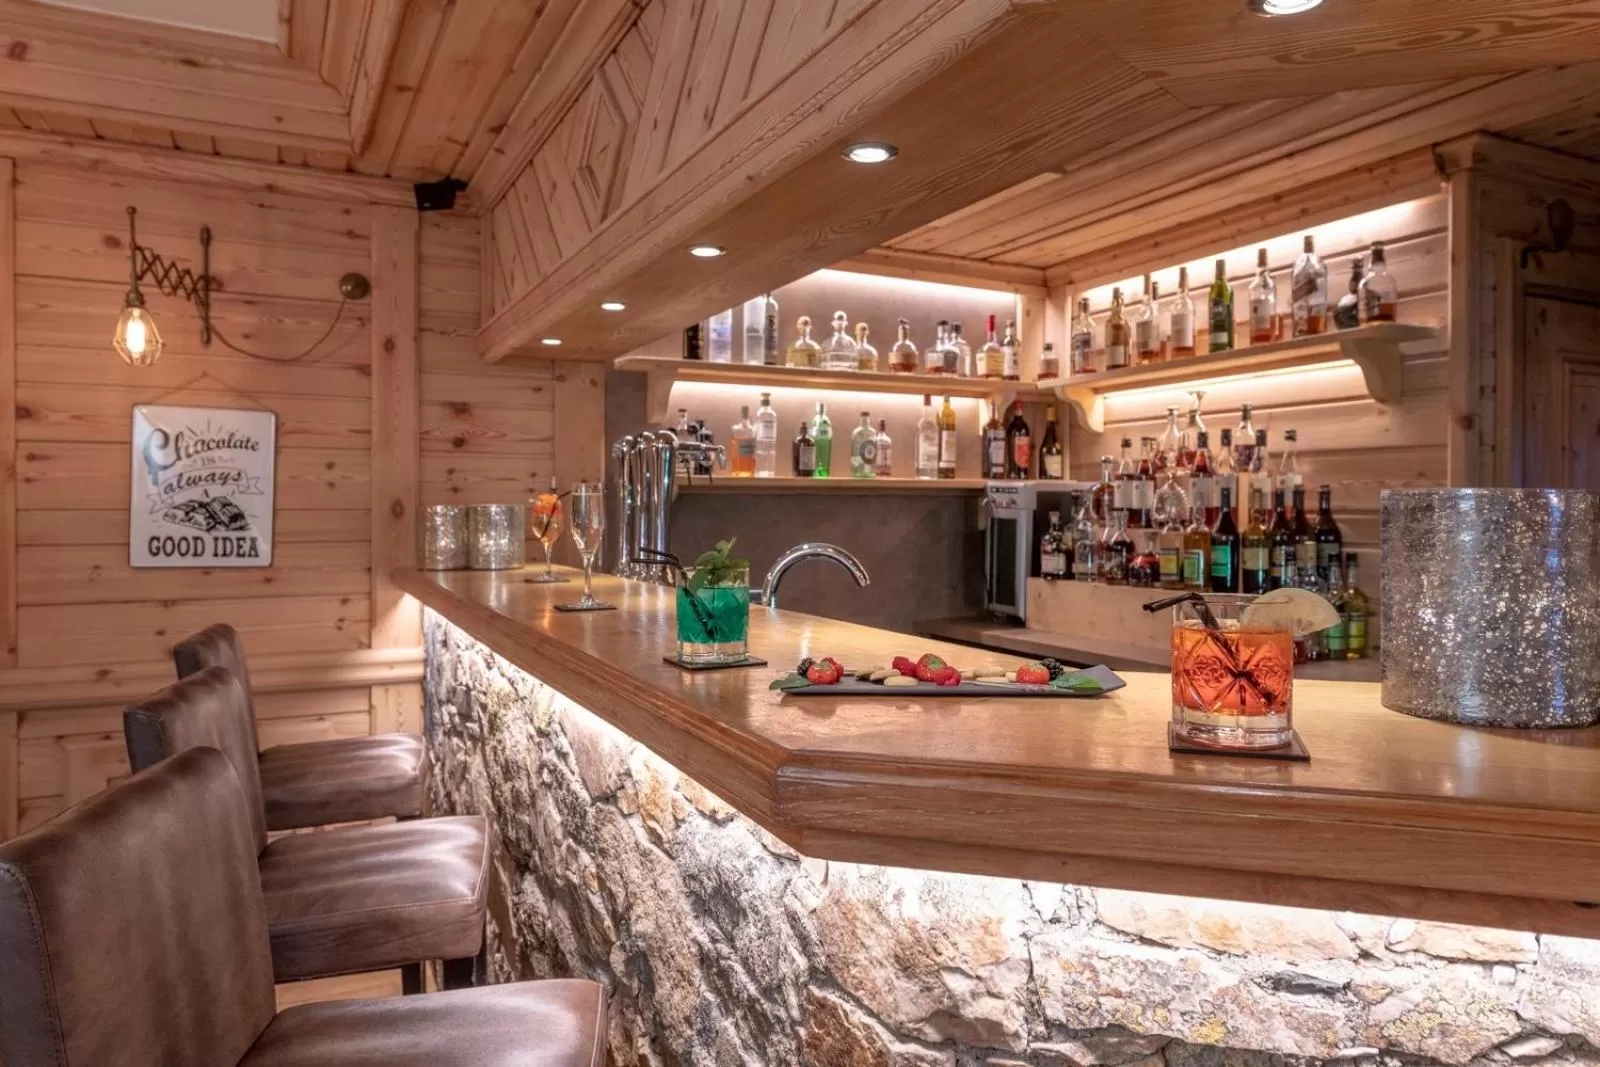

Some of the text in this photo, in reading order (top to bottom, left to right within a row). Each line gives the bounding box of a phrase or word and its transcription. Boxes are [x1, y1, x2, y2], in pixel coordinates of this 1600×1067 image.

[142, 428, 260, 471] Chocolate
[163, 470, 242, 495] always
[148, 536, 260, 558] GOOD IDEA
